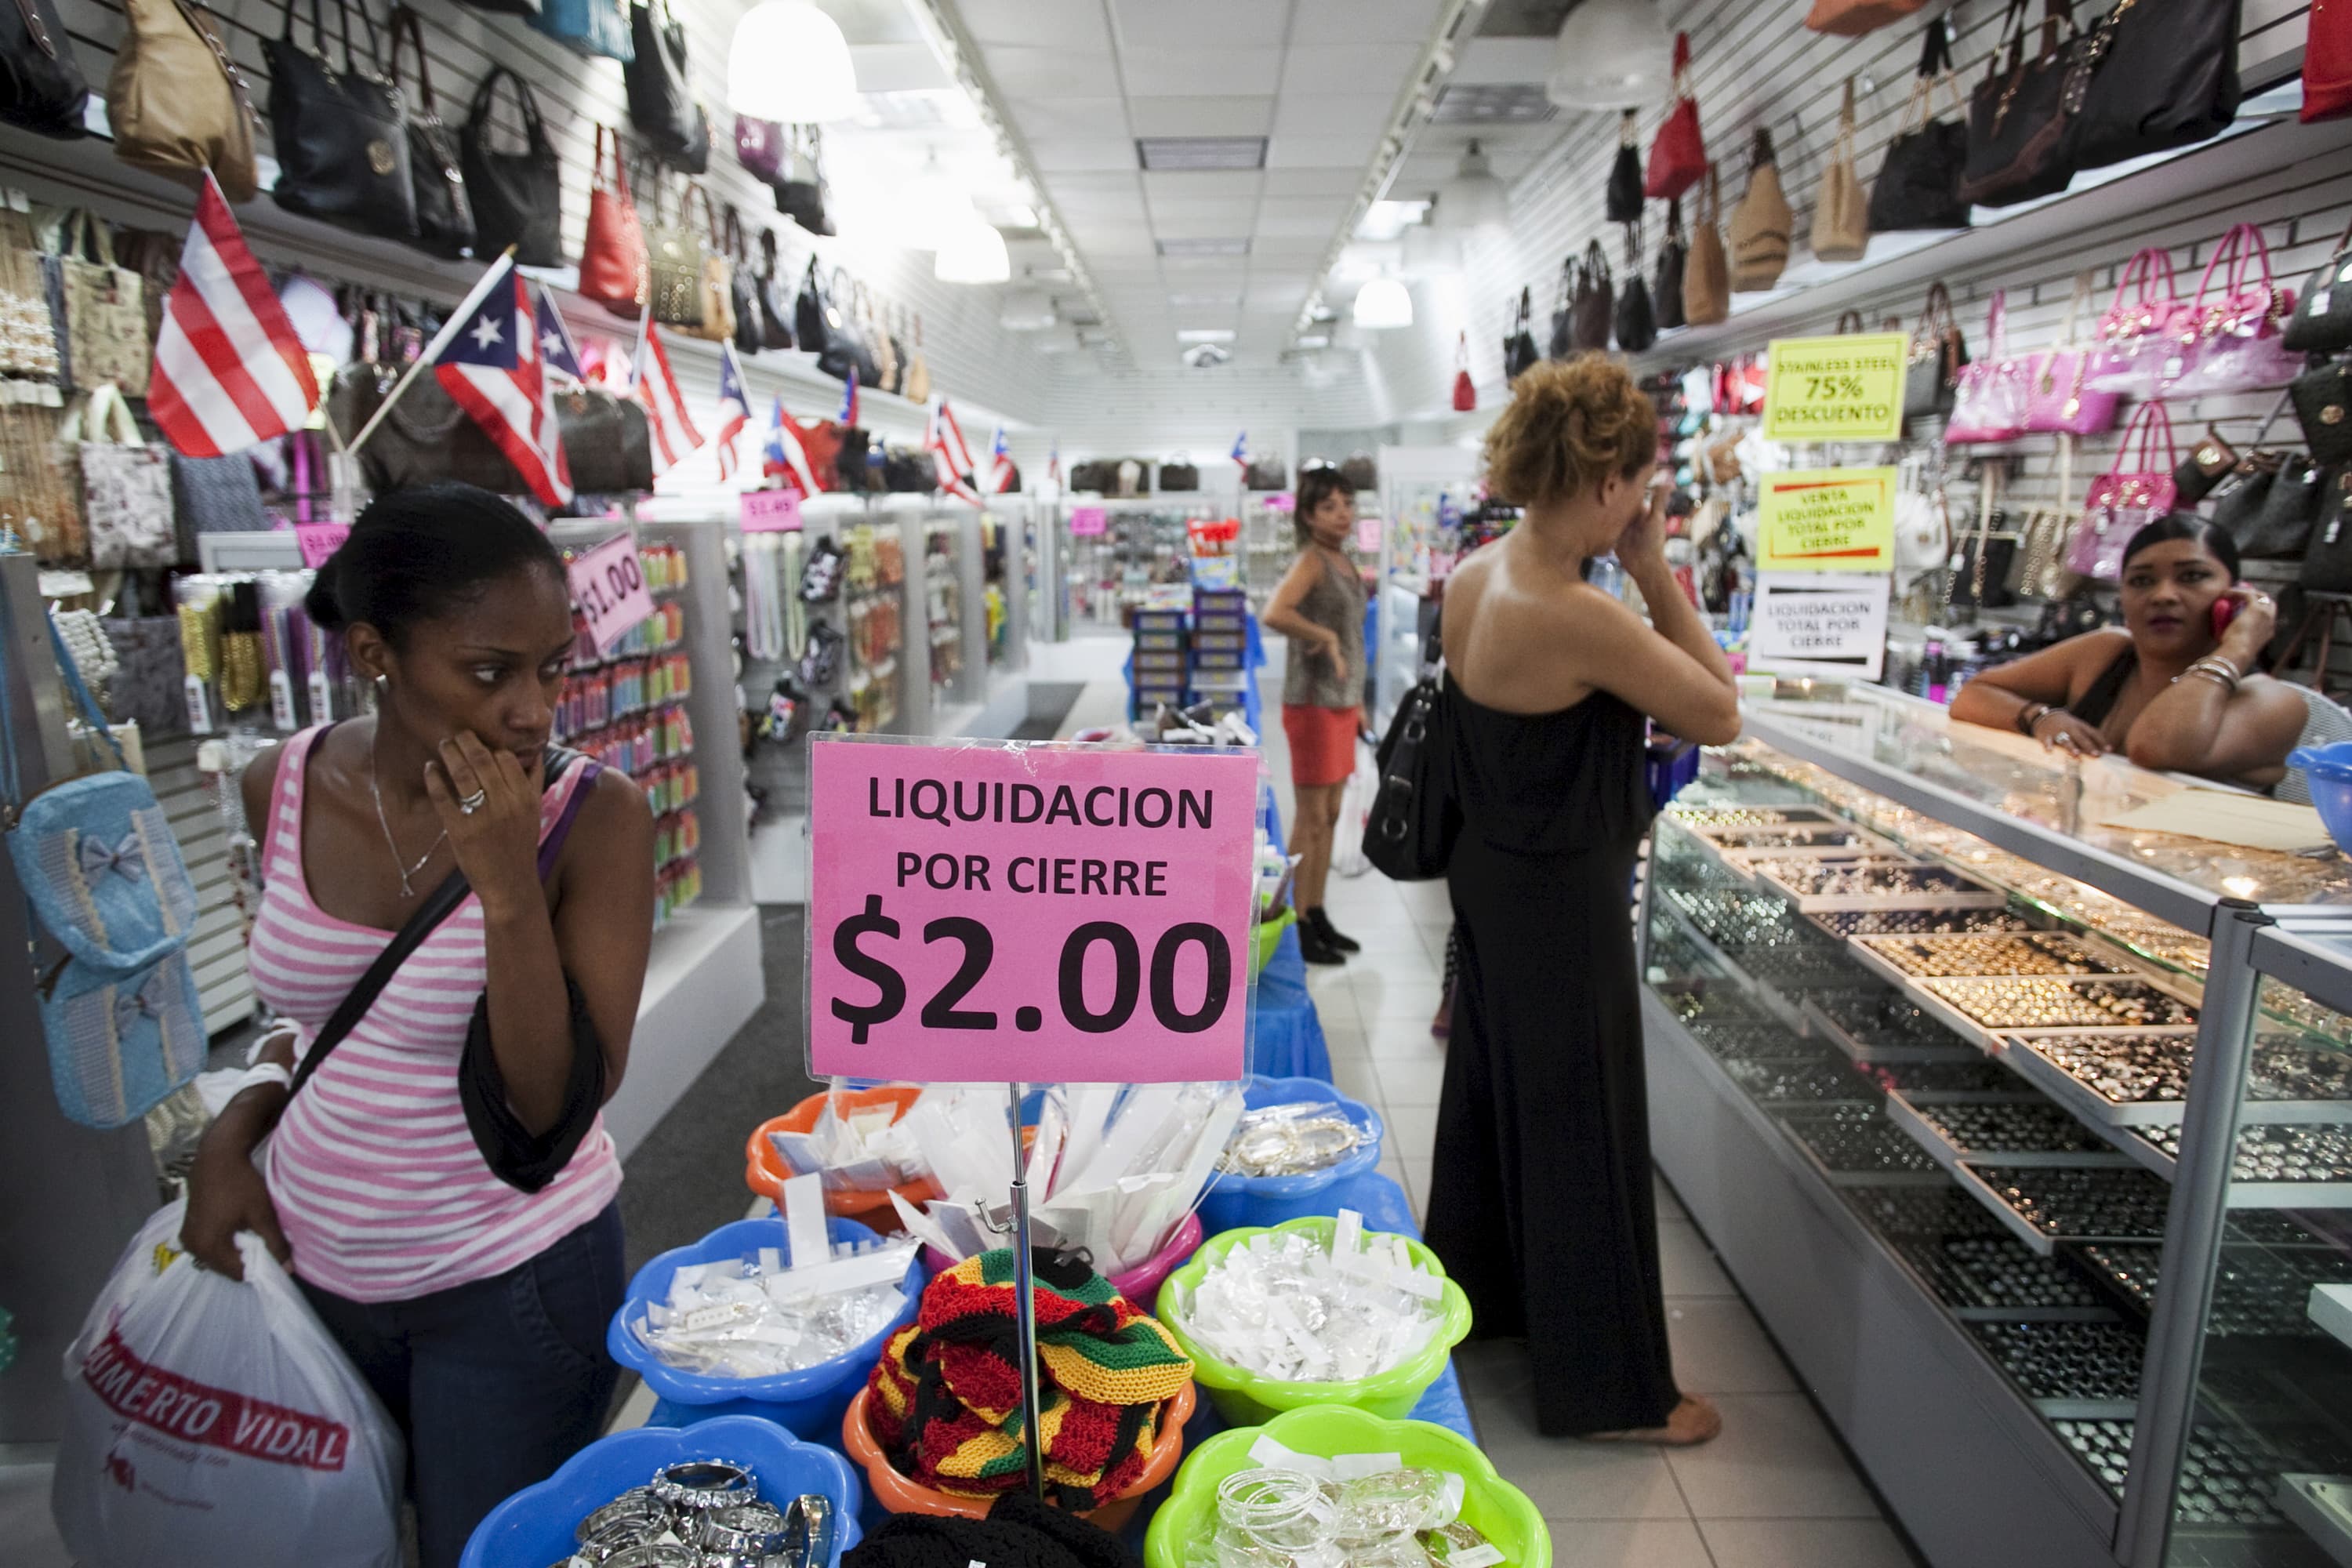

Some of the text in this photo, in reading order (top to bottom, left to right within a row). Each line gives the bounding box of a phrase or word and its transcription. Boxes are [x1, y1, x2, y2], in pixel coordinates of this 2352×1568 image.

[1777, 358, 1898, 373] STAINLESS STEEL
[1806, 375, 1864, 401] 75%
[1776, 403, 1889, 423] DESCUENTO
[1802, 490, 1848, 503] VENTA
[1778, 502, 1875, 521] LIQUIDACION
[1788, 519, 1864, 535] TOTAL POR
[1801, 536, 1849, 548] CIERRE
[583, 555, 641, 625] $1.00
[1767, 601, 1871, 616] LIQUIDACION
[1777, 618, 1860, 631] TOTAL POR
[1790, 636, 1843, 648] CIERRE
[869, 777, 1213, 829] LIQUIDACION
[896, 851, 1167, 896] POR CIERRE
[830, 894, 1232, 1045] $2.00
[233, 1408, 341, 1465] VIDAL
